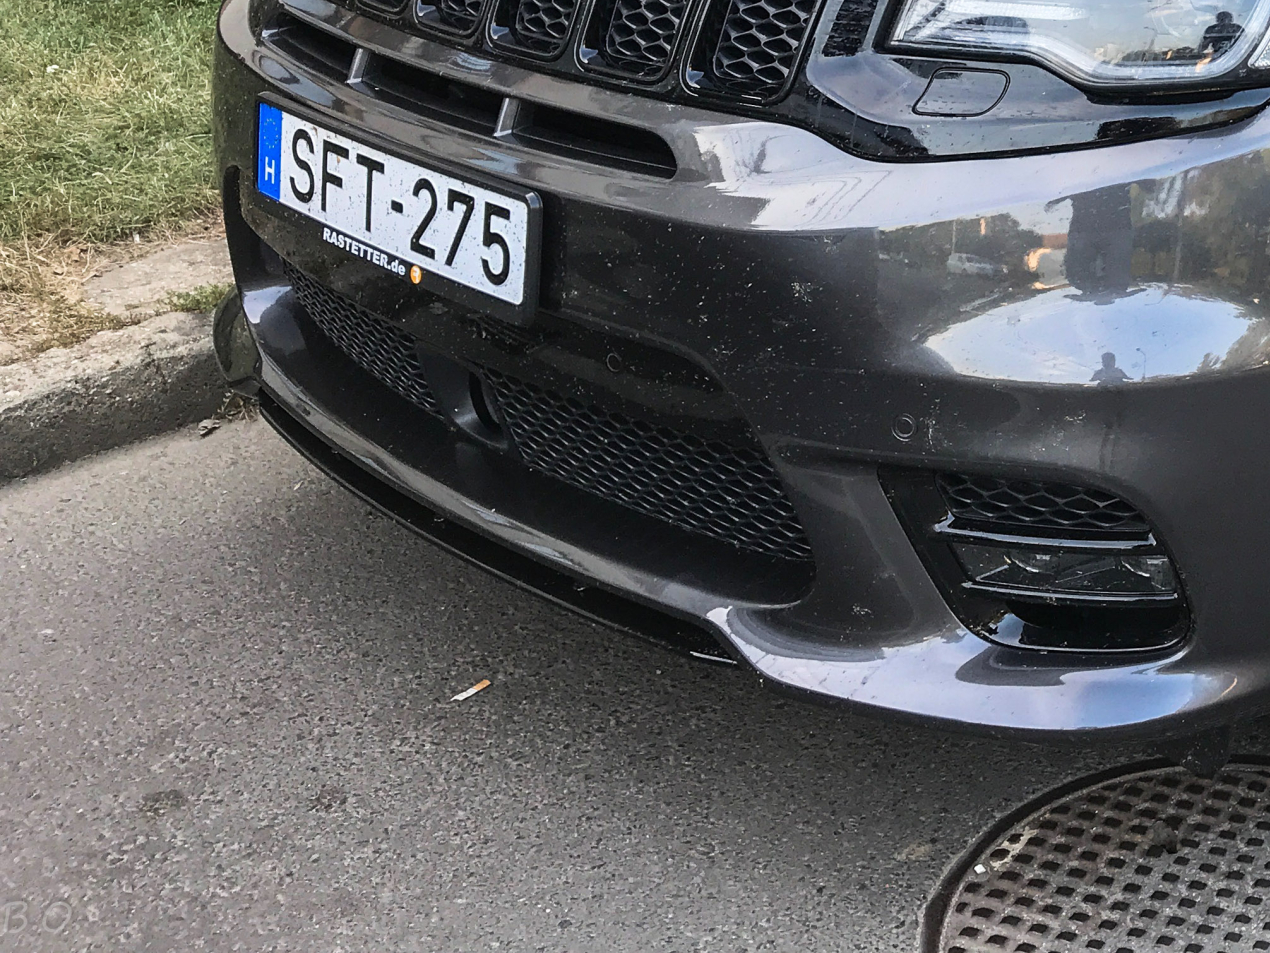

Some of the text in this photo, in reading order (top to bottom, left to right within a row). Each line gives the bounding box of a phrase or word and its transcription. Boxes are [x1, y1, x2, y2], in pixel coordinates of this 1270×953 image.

[264, 155, 276, 185] H
[289, 128, 511, 286] SFT-275
[322, 227, 407, 276] RASTETTER.de
